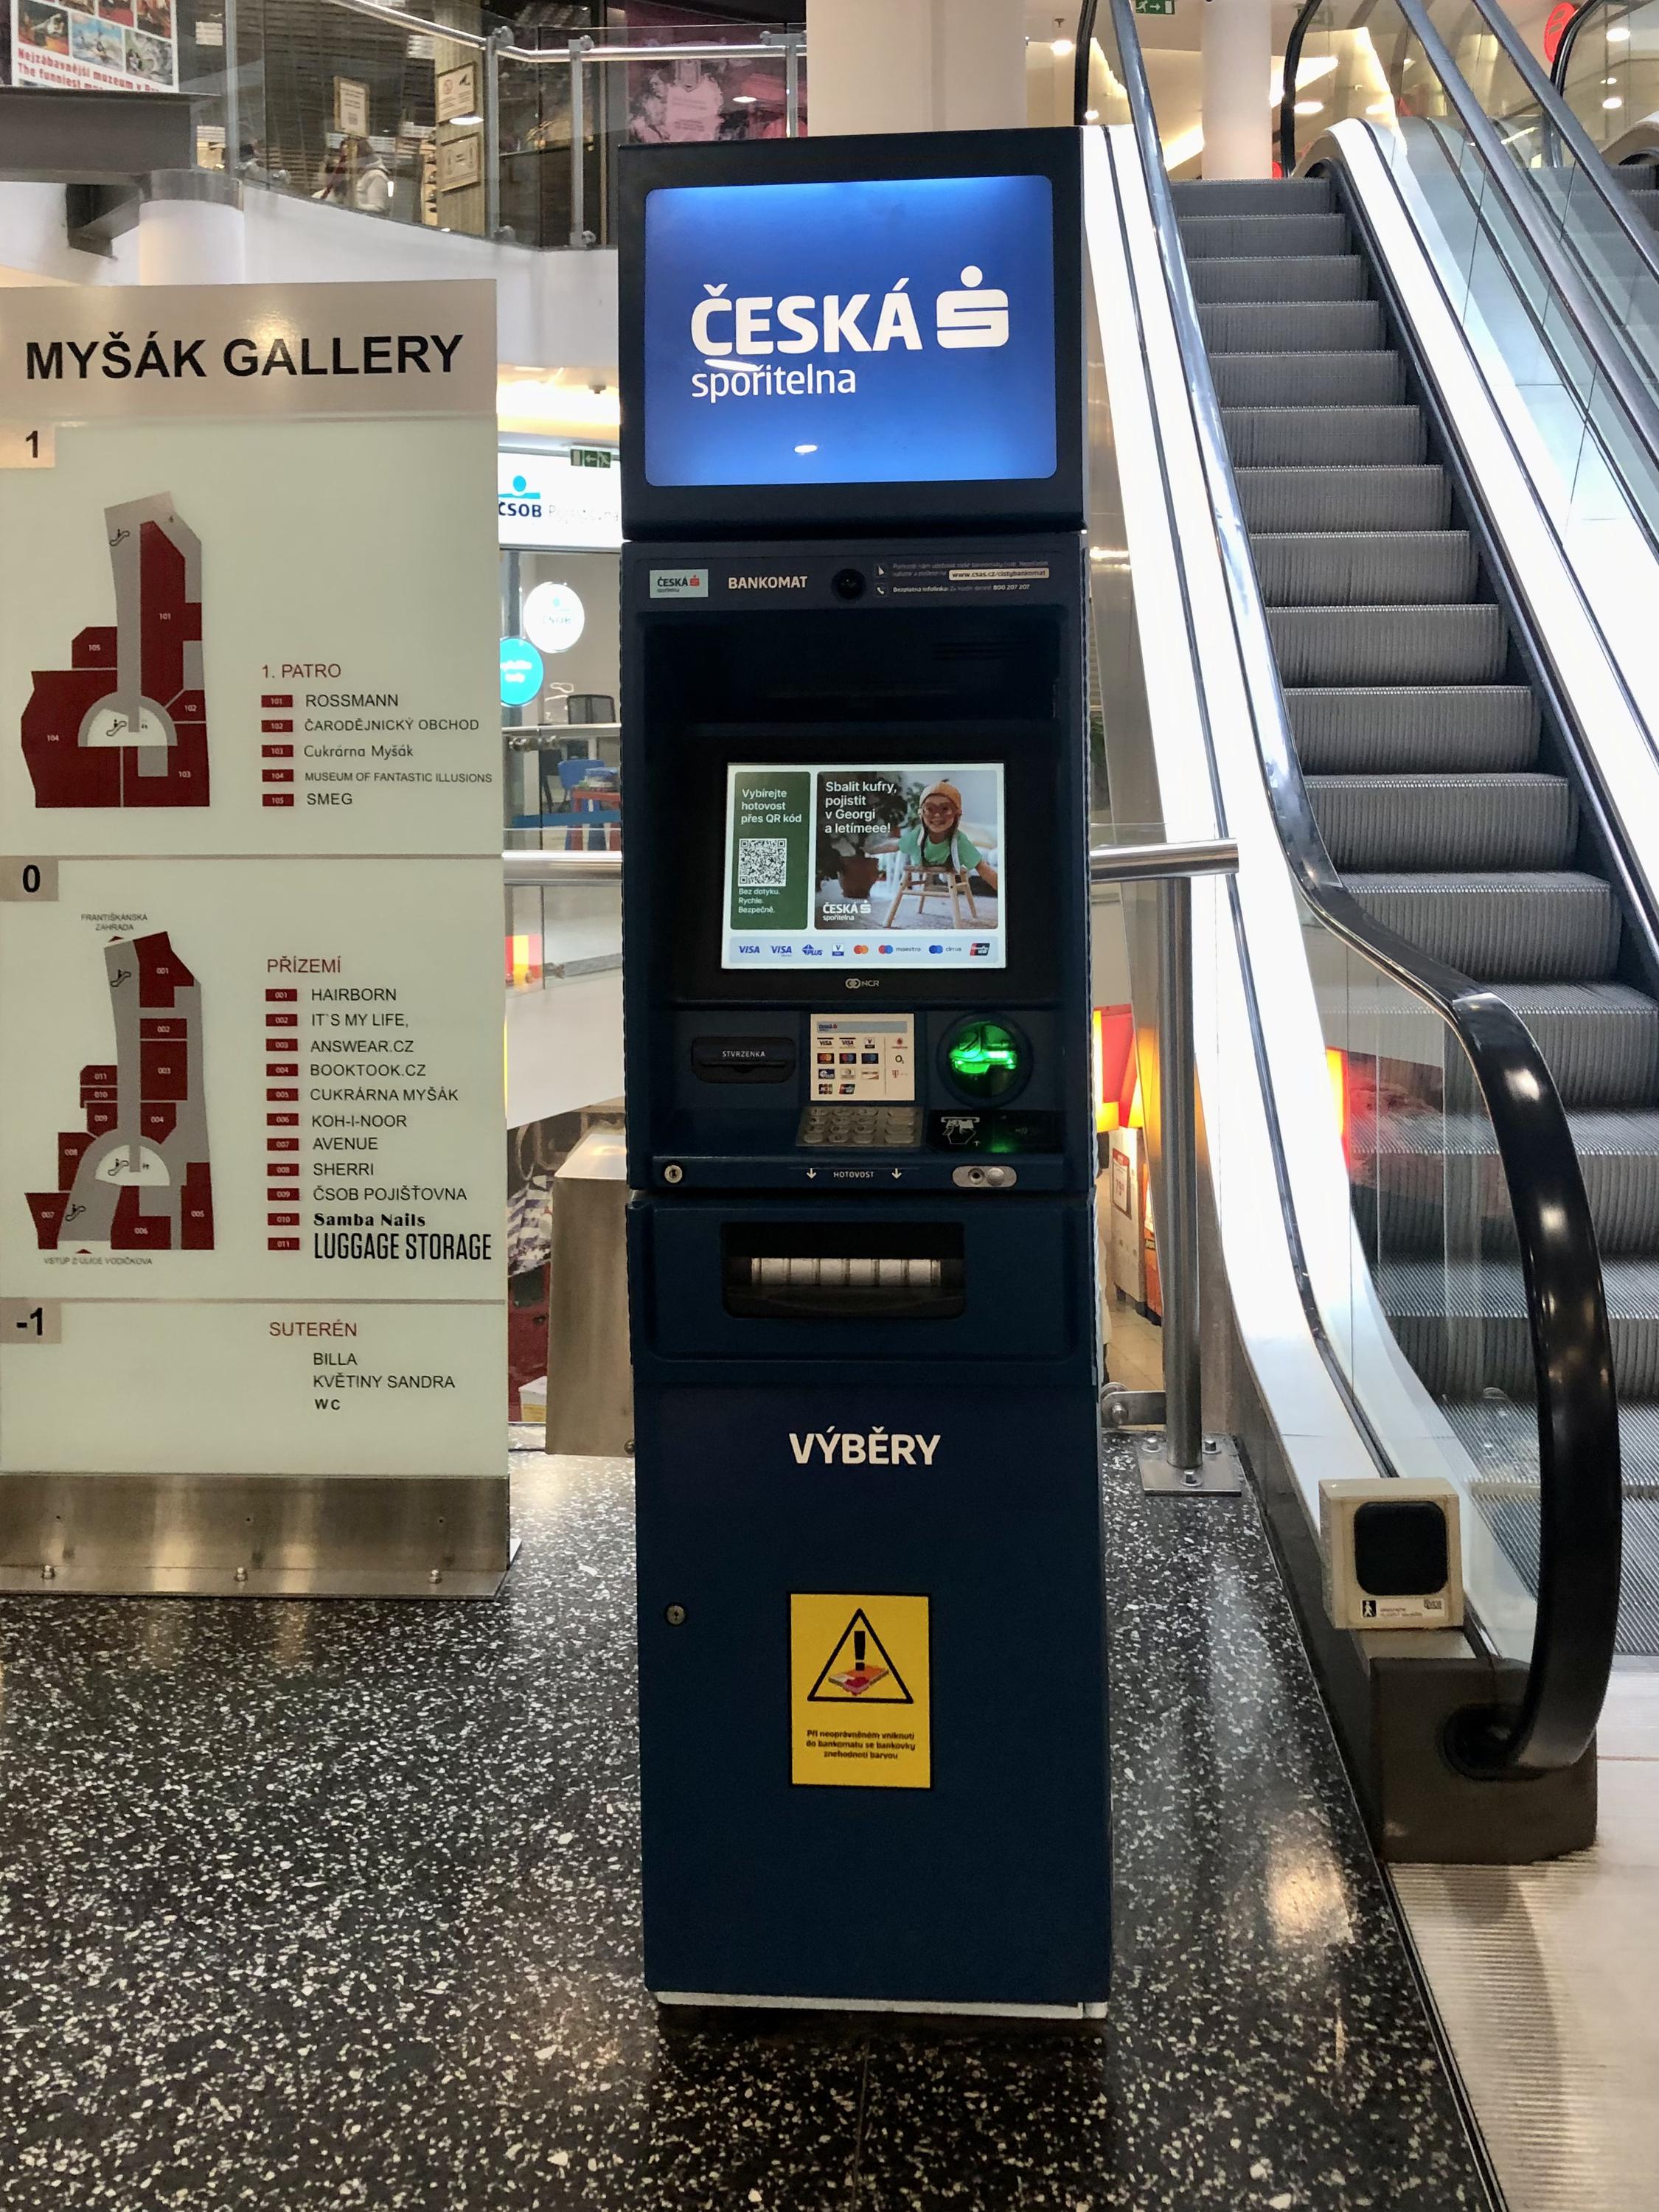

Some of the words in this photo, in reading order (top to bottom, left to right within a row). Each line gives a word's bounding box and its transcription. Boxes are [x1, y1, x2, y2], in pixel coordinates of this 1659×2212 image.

[18, 63, 36, 76] The
[39, 69, 82, 88] funniest
[93, 71, 133, 89] muzeum
[691, 277, 923, 356] ČESKÁ
[27, 331, 206, 379] MYŠÁK
[223, 334, 464, 378] GALLERY
[692, 364, 856, 403] spořitelna
[25, 431, 38, 459] 1
[657, 575, 689, 588] ČESKÁ
[728, 576, 808, 589] BANKOMAT
[262, 664, 275, 678] 1.
[282, 664, 341, 678] PATRO
[306, 694, 399, 707] ROSSMANN
[305, 717, 414, 731] ČARODĚJNICKÝ
[418, 719, 479, 731] OBCHOD
[304, 745, 366, 757] Cukrárna
[371, 744, 414, 760] Myšák
[305, 773, 353, 782] MUSEUM
[356, 773, 370, 782] OF
[374, 773, 433, 782] FANTASTIC
[436, 773, 493, 783] ILLUSIONS
[742, 788, 787, 799] Vybírejte
[825, 781, 860, 793] Sbalit
[863, 781, 897, 795] kufry,
[307, 793, 353, 805] SMEG
[742, 801, 785, 810] hotovost
[825, 795, 866, 808] pojistit
[741, 814, 764, 824] přes
[765, 814, 781, 823] QR
[783, 813, 802, 823] kód
[826, 811, 832, 819] v
[835, 809, 876, 822] Georgi
[824, 825, 832, 833] a
[835, 822, 891, 833] letímeee!
[23, 864, 41, 893] 0
[823, 902, 858, 914] ČESKÁ
[267, 956, 341, 973] PŘÍZEMÍ
[311, 988, 397, 1001] HAIRBORN
[345, 1014, 368, 1026] MY
[372, 1014, 408, 1028] LIFE,
[310, 1040, 414, 1053] ANSWEAR.CZ
[310, 1064, 426, 1077] BOOKTOOK.CZ
[310, 1086, 399, 1101] CUKRÁRNA
[403, 1086, 459, 1101] MYŠÁK
[312, 1115, 407, 1127] KOH-I-NOOR
[313, 1138, 378, 1150] AVENUE
[313, 1163, 374, 1176] SHERRI
[313, 1185, 359, 1201] ČSOB
[364, 1185, 467, 1201] POJIŠŤOVNA
[313, 1213, 374, 1227] Samba
[380, 1213, 425, 1227] Nails
[315, 1233, 400, 1259] LUGGAGE
[406, 1234, 492, 1260] STORAGE
[16, 1307, 43, 1336] -1
[270, 1319, 357, 1337] SUTERÉN
[313, 1352, 358, 1366] BILLA
[313, 1372, 382, 1388] KVĚTINY
[387, 1375, 456, 1388] SANDRA
[789, 1426, 941, 1465] VÝBĚRY
[818, 1740, 863, 1748] bankomatu
[877, 1742, 916, 1750] bankovky
